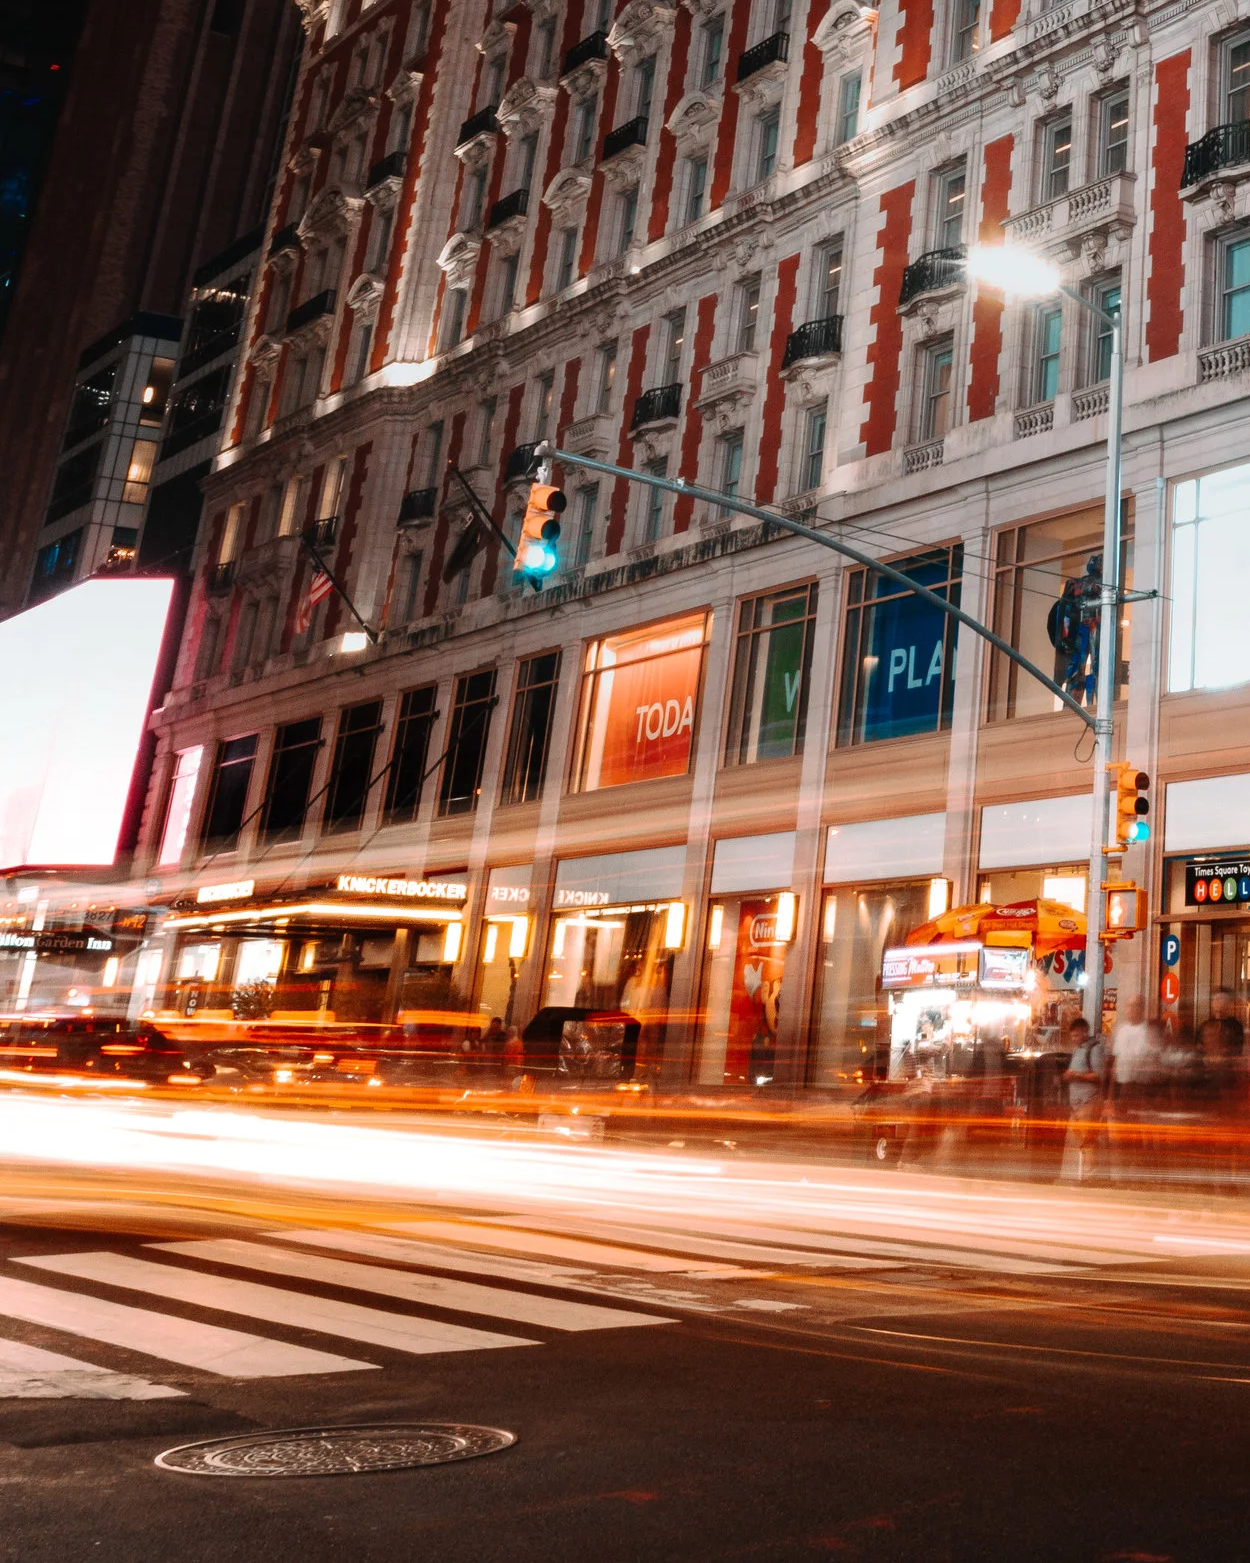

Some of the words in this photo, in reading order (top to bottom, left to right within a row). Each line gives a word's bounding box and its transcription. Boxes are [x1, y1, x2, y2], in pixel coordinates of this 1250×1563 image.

[888, 640, 957, 693] PLA
[636, 696, 693, 743] TODA
[1194, 867, 1214, 877] Times
[1214, 866, 1238, 878] Square
[338, 875, 467, 899] KNICKERBOCKER
[36, 936, 84, 949] Garden
[87, 937, 112, 950] Inn
